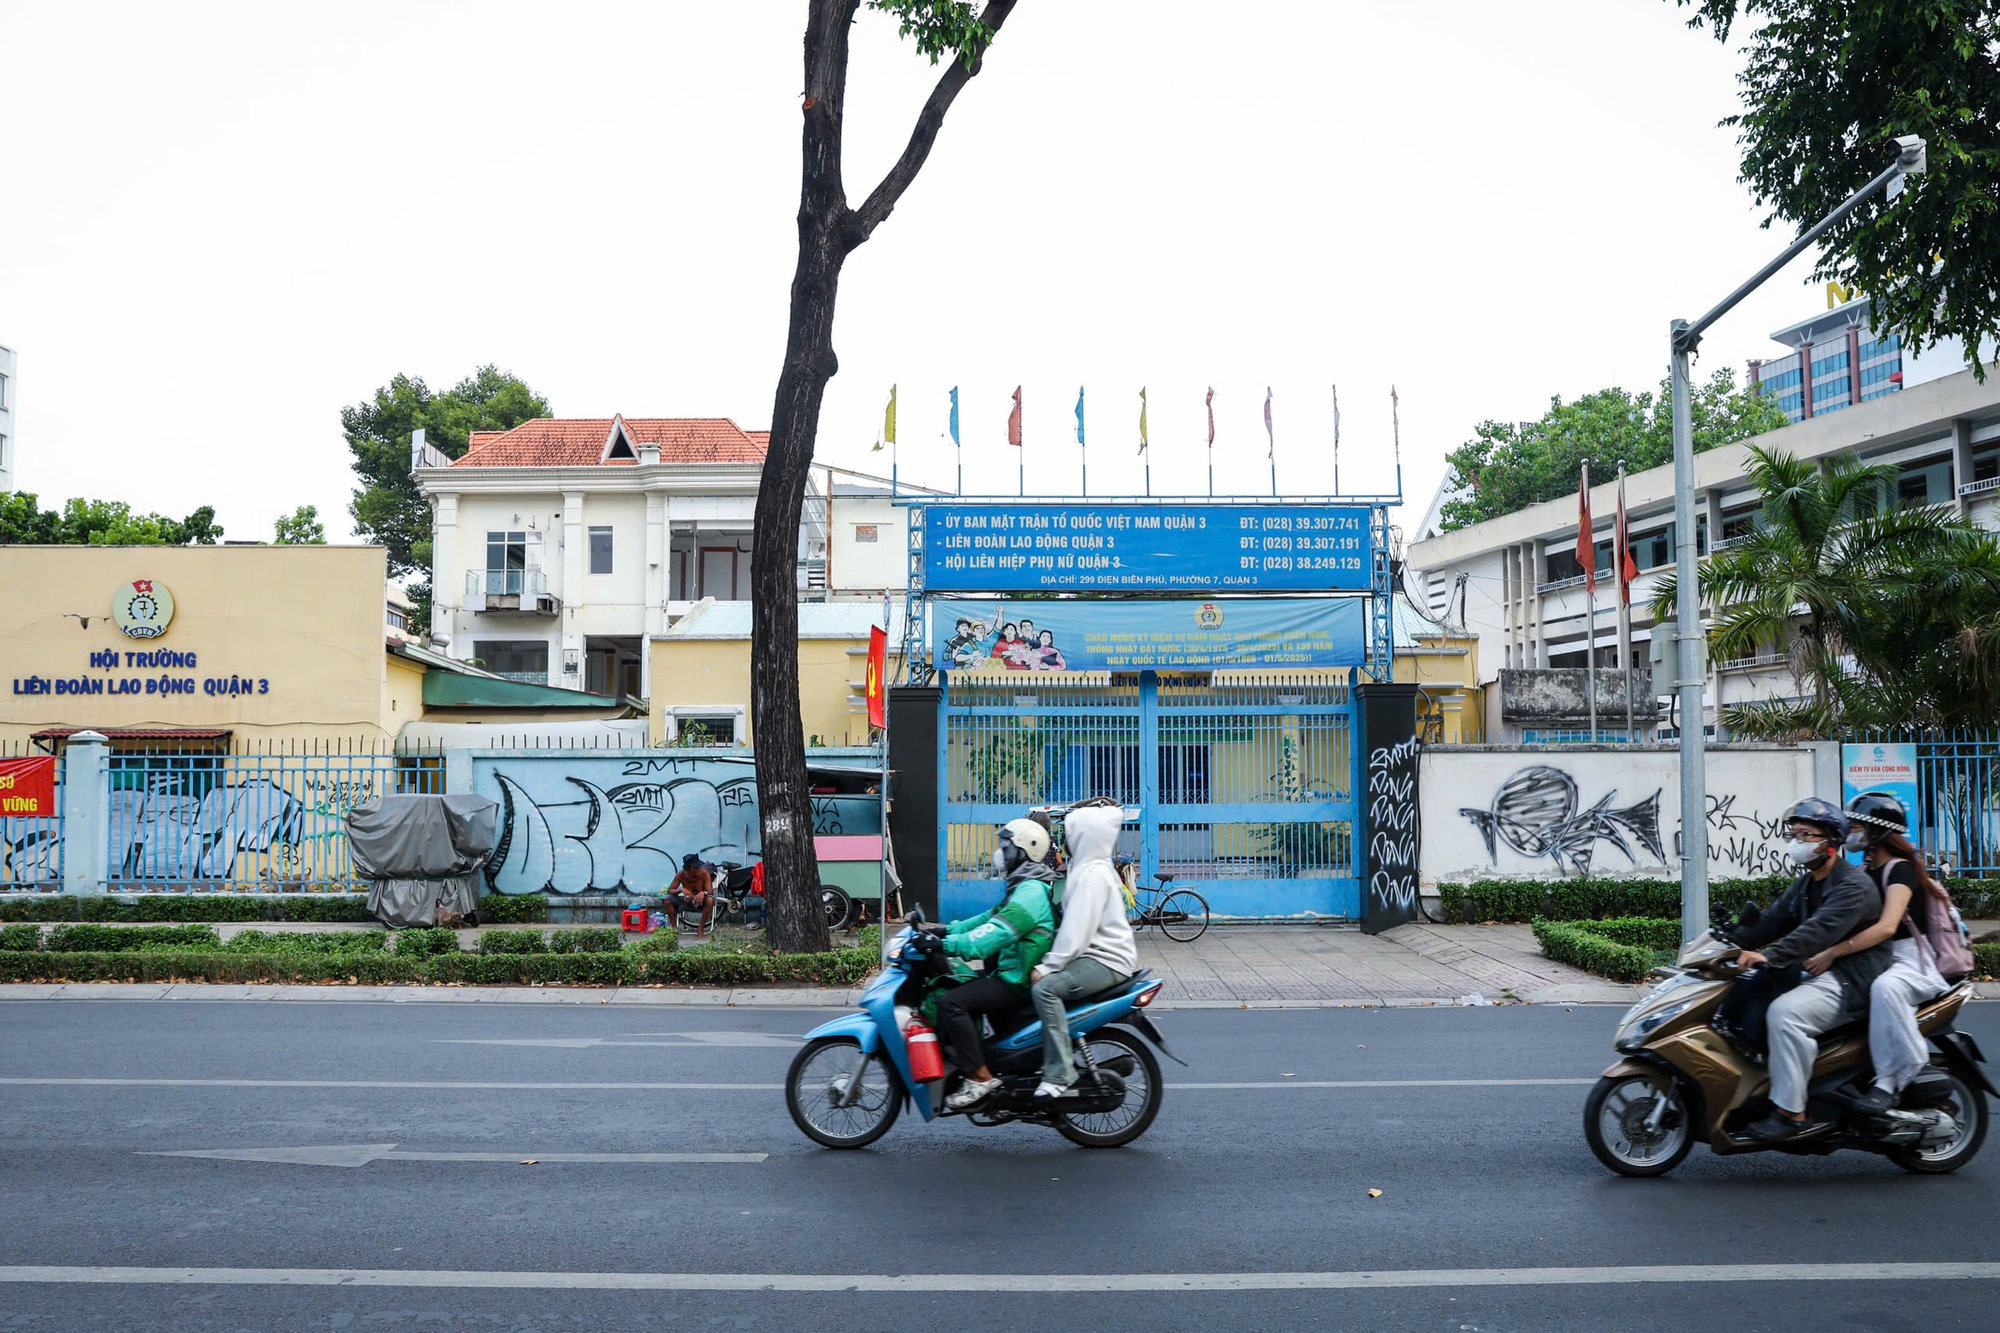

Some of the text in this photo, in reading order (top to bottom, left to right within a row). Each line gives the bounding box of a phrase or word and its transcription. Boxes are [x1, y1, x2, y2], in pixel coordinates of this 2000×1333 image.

[946, 512, 960, 528] ỦY
[964, 516, 987, 528] BAN
[991, 513, 1015, 530] MẶT
[1019, 513, 1048, 530] TRẬN
[1052, 510, 1067, 528] TỔ
[1071, 511, 1102, 530] QUỐC
[1106, 513, 1131, 530] VIỆT
[1135, 516, 1160, 528] NAM
[1164, 513, 1195, 531] QUẬN
[1199, 517, 1207, 529] 3
[1262, 517, 1292, 532] (028)
[1296, 517, 1359, 530] 39.307.741
[946, 533, 970, 548] LIÊN
[974, 533, 1007, 549] ĐOÀN
[1010, 536, 1032, 548] LAO
[1035, 533, 1068, 550] ĐỘNG
[1072, 533, 1103, 551] QUẬN
[1107, 536, 1115, 549] 3
[1263, 537, 1292, 552] (028)
[1296, 537, 1360, 550] 39.307.191
[946, 553, 966, 571] HỘI
[970, 553, 995, 568] LIÊN
[999, 553, 1026, 571] HIỆP
[1030, 556, 1053, 571] PHỤ
[1057, 553, 1075, 568] NỮ
[1078, 552, 1109, 571] QUẬN
[1112, 556, 1120, 569] 3
[1263, 557, 1293, 572] (028)
[1297, 557, 1361, 570] 38.249.129
[1041, 575, 1056, 586] ĐỊA
[1080, 575, 1095, 584] 299
[1097, 573, 1118, 586] ĐIỆN
[1121, 572, 1143, 584] BIÊN
[1170, 573, 1211, 584] PHƯỜNG
[1223, 573, 1249, 586] QUẬN
[1252, 576, 1258, 584] 3
[90, 648, 197, 671] HỘI TRƯỜNG
[1169, 656, 1184, 664] LAO
[13, 675, 269, 698] LIÊN ĐOÀN LAO ĐỘNG QUẬN 3
[3, 795, 38, 812] VỮNG
